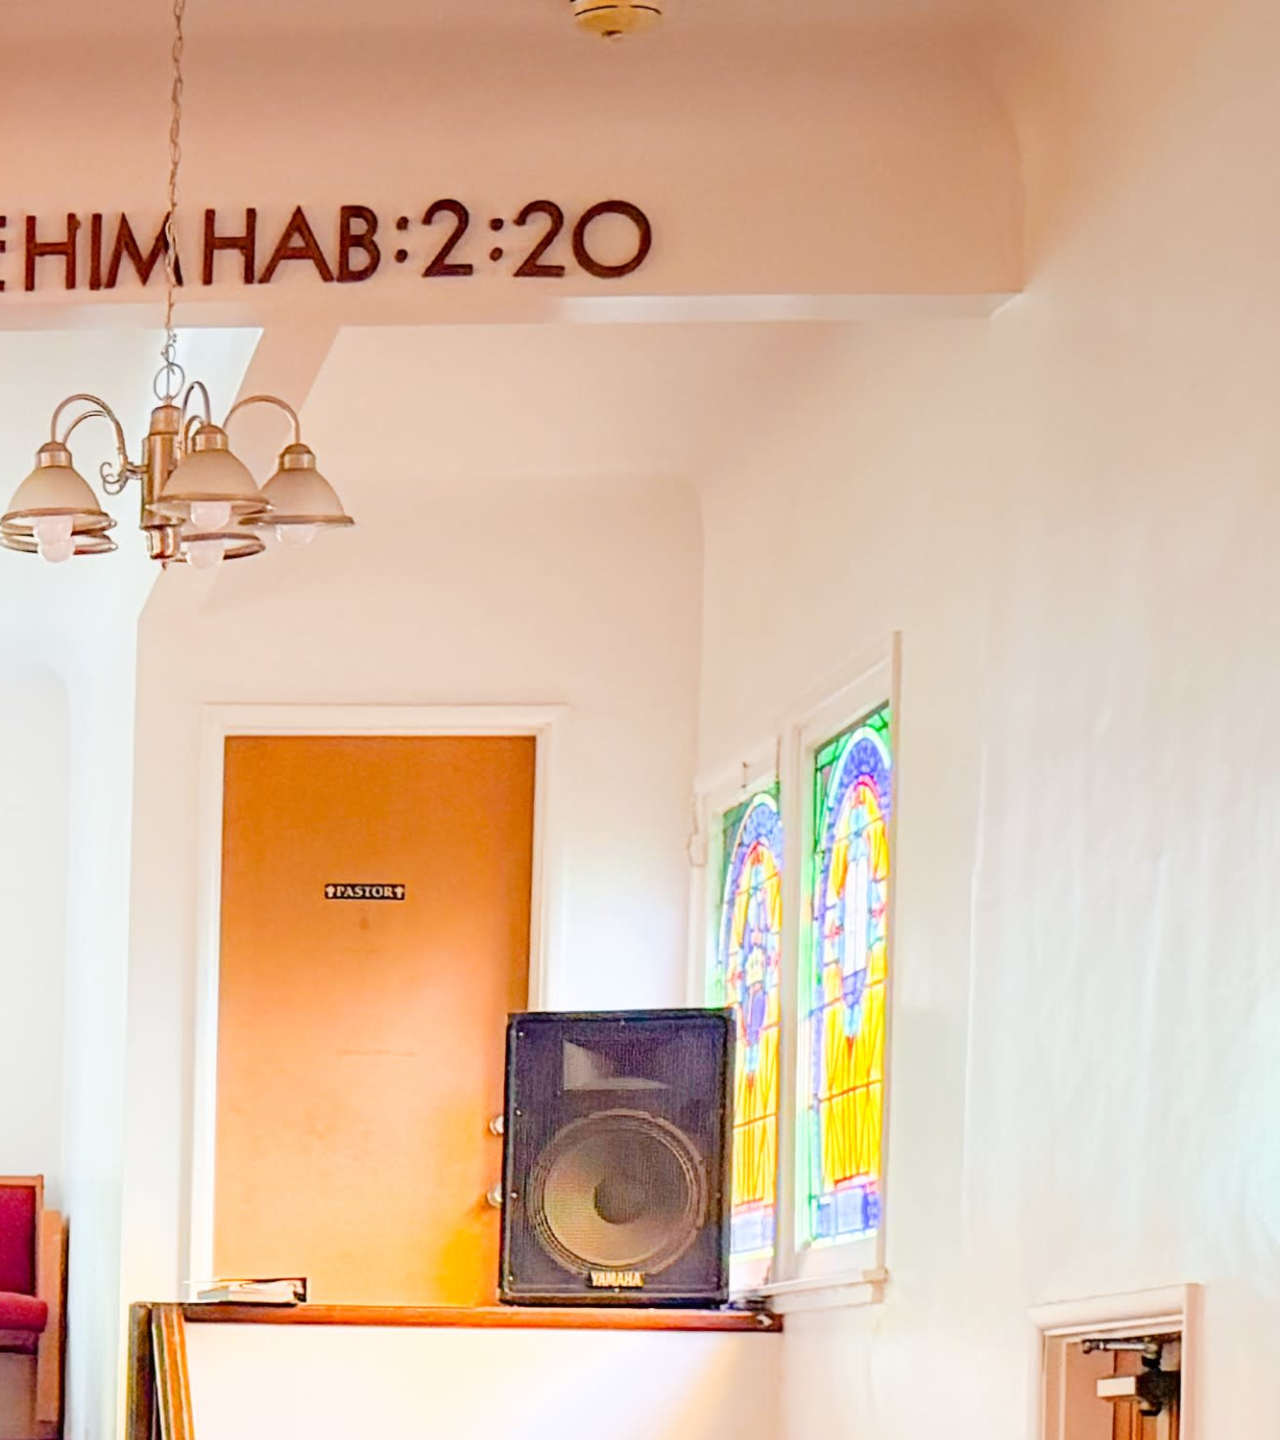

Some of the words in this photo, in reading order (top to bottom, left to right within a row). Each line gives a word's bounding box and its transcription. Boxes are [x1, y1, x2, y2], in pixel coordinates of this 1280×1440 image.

[25, 212, 183, 291] HIM
[336, 885, 394, 898] PASTOR
[590, 1271, 645, 1287] YAMAHA
